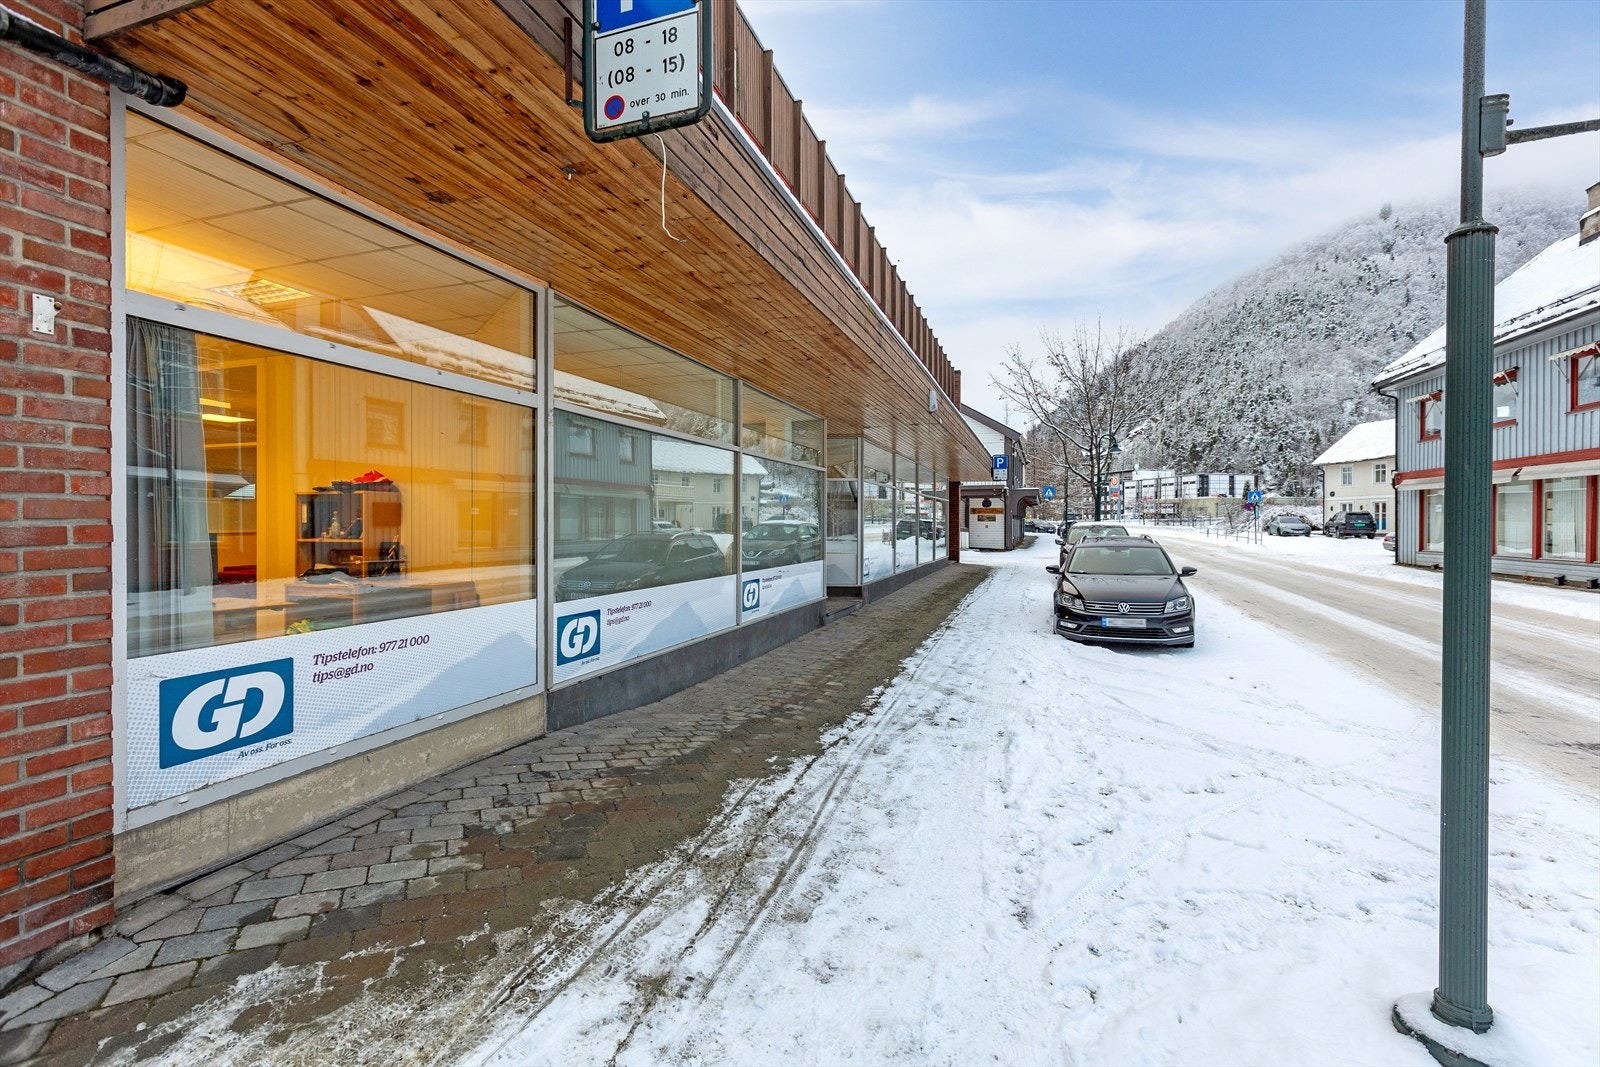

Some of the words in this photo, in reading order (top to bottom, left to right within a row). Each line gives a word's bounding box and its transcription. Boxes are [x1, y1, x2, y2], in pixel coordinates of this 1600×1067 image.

[614, 38, 634, 57] 08
[662, 27, 678, 45] 18
[608, 66, 635, 88] (08
[662, 53, 685, 74] 15)
[630, 97, 650, 108] over
[655, 92, 666, 102] 30
[671, 88, 689, 99] min.
[997, 458, 1004, 468] P
[313, 646, 377, 666] Tipstelefon:
[379, 640, 398, 653] 977
[398, 638, 408, 649] 21
[408, 634, 430, 648] 000
[560, 616, 598, 658] GD
[312, 662, 374, 684] tips@gd.no
[171, 671, 285, 751] GD
[237, 750, 250, 759] Av
[265, 741, 280, 750] For
